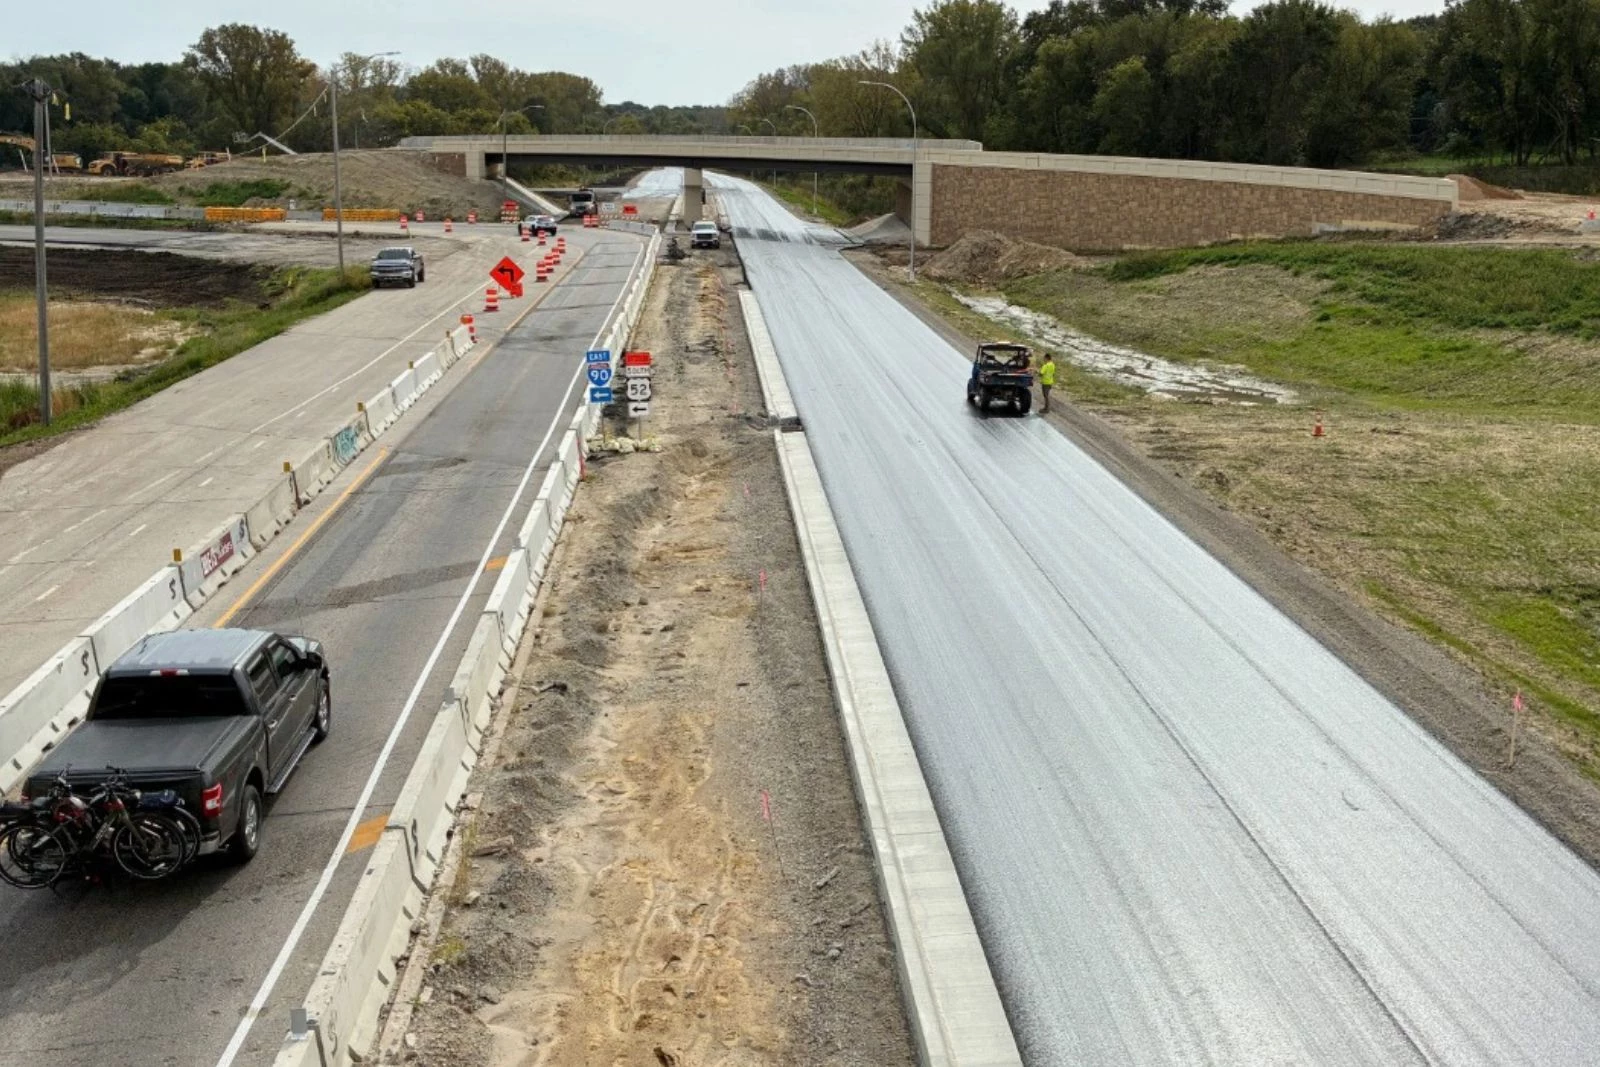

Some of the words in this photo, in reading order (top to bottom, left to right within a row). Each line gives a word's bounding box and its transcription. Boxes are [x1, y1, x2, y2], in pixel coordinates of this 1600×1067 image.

[589, 353, 607, 361] EAST
[590, 370, 609, 381] 90
[630, 384, 647, 396] 52
